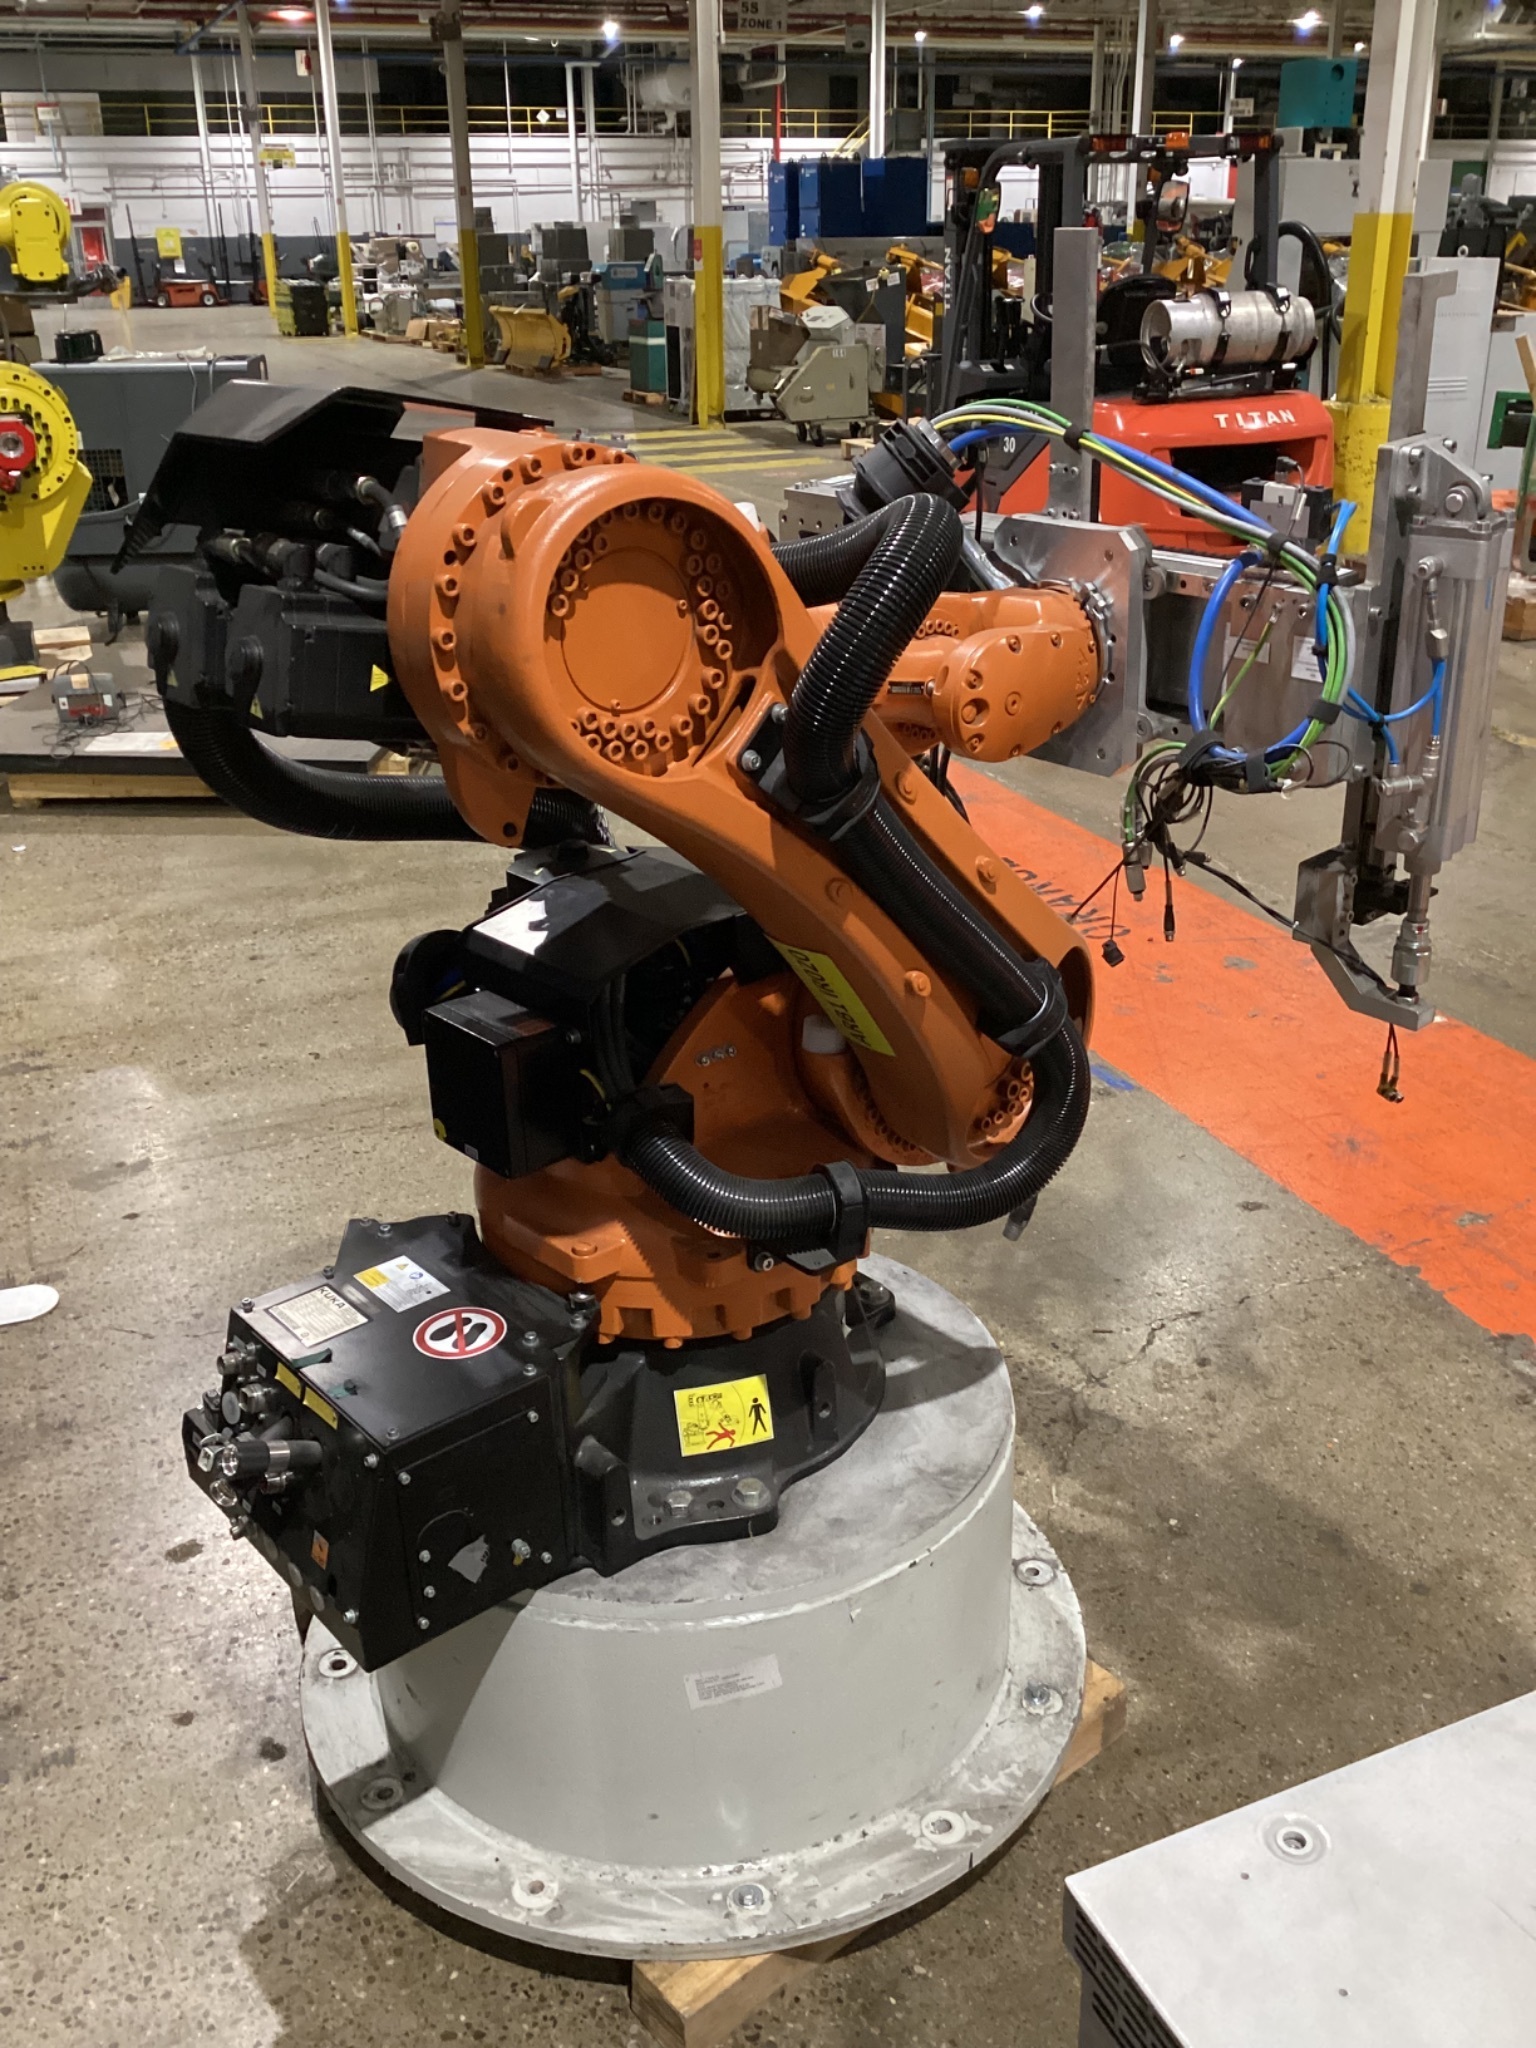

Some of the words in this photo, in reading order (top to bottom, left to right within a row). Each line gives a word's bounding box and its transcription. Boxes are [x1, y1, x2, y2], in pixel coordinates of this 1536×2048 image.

[741, 2, 759, 14] 5S
[740, 17, 773, 30] ZONE
[776, 20, 782, 30] 1
[944, 247, 952, 317] TITAN
[1212, 408, 1296, 429] TITAN
[1003, 436, 1016, 453] 30
[318, 1286, 346, 1309] KUKA
